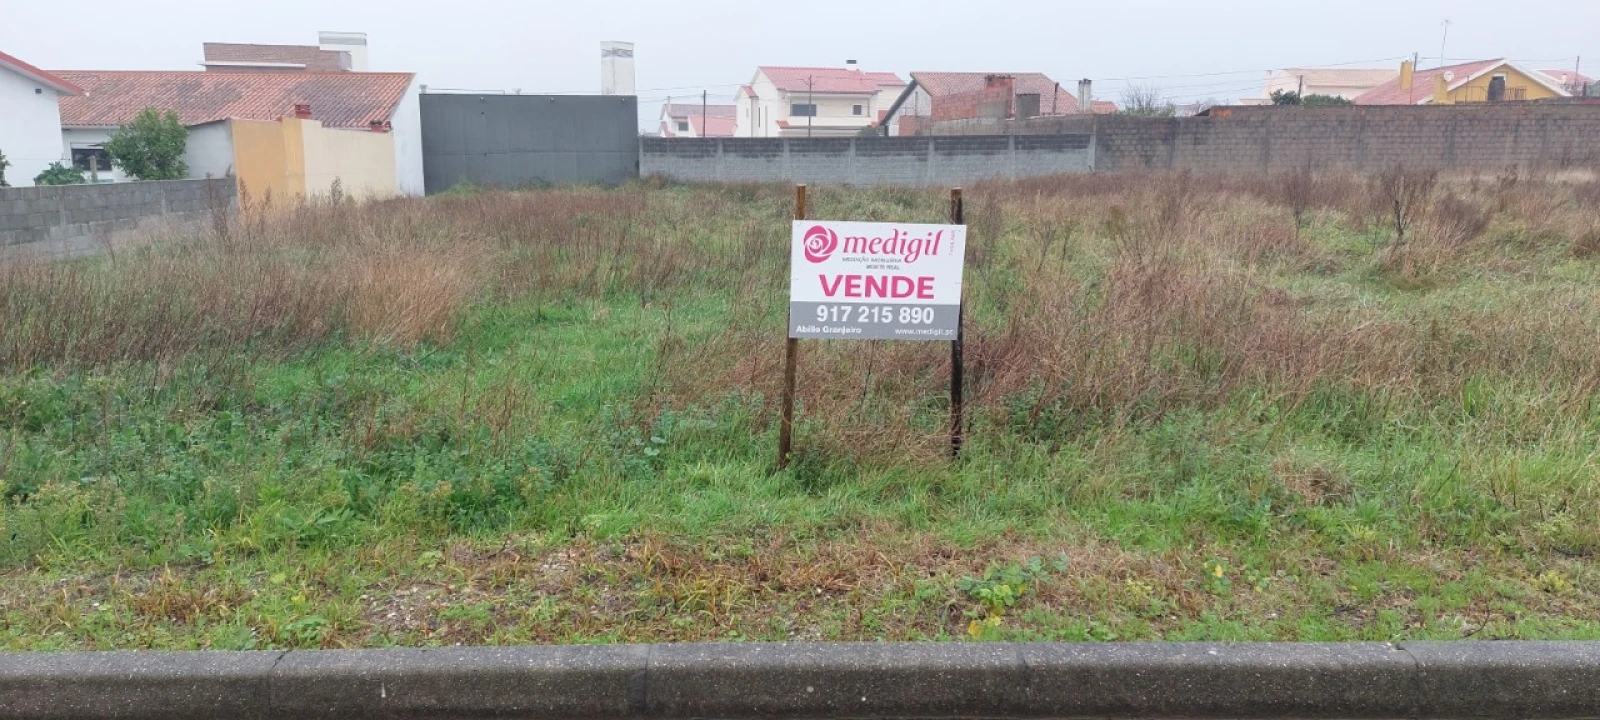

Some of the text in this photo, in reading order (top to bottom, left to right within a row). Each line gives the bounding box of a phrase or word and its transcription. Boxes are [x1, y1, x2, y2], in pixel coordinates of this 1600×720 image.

[842, 228, 944, 264] medigil
[819, 274, 935, 299] VENDE
[816, 305, 935, 324] 917 215 890
